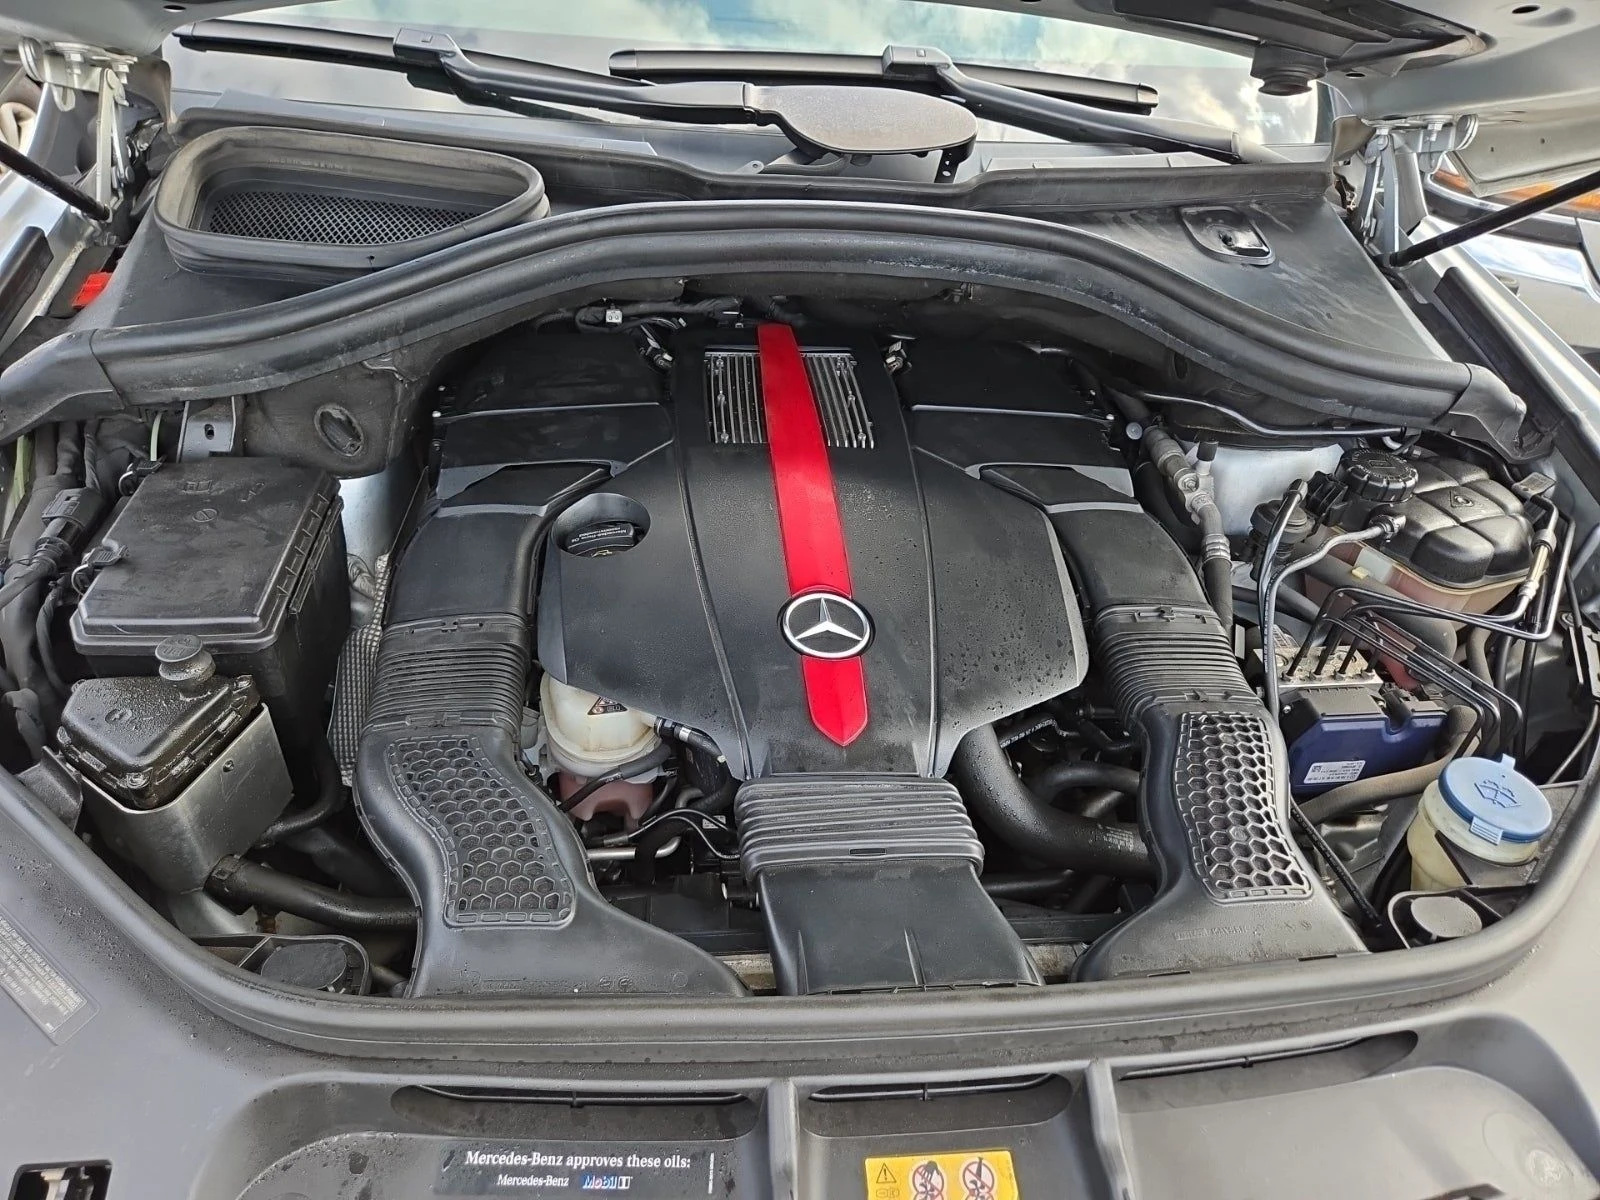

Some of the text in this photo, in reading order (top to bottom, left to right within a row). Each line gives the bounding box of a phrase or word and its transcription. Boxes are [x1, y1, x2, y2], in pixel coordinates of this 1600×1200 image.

[465, 1151, 691, 1169] Mercedes-Benz approves these oils:
[497, 1174, 570, 1187] Mercedes-Benz
